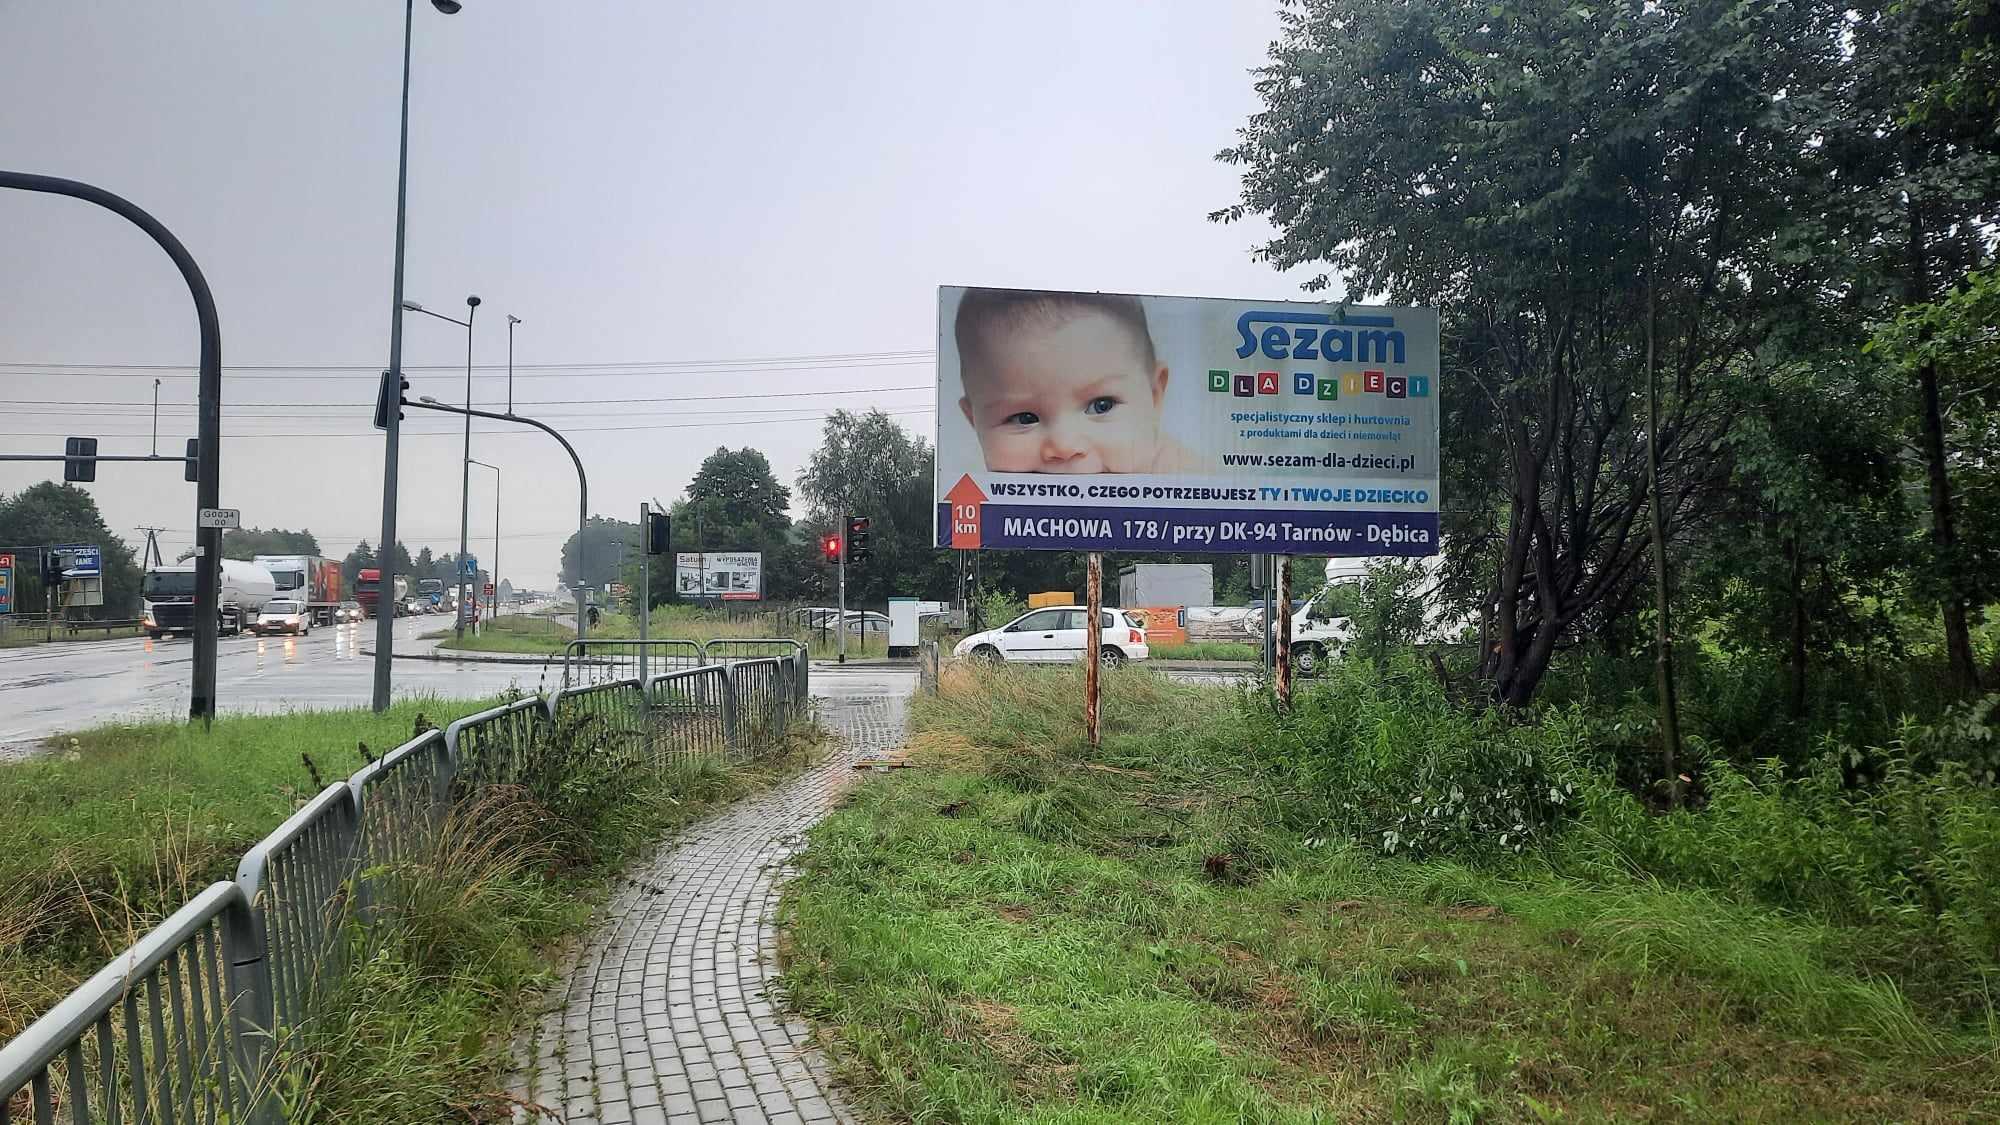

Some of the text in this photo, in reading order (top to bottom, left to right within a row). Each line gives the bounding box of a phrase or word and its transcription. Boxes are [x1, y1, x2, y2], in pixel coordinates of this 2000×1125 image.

[1236, 311, 1405, 363] Sezam
[1212, 374, 1422, 397] DLA DZIECI
[1231, 411, 1314, 426] specjalistyczny
[1316, 412, 1346, 427] sklep
[1354, 413, 1410, 426] hurtownia
[1247, 428, 1302, 439] produktami
[1304, 428, 1318, 439] dla
[1320, 429, 1346, 440] dzieci
[1223, 452, 1415, 472] www.sezam-dla-dzieci.pl
[990, 483, 1084, 499] WSZYSTKO,
[1087, 485, 1140, 499] CZEGO
[1142, 486, 1256, 501] POTRZEBUJESZ
[1259, 487, 1281, 501] TY
[1290, 487, 1351, 502] TWOJE
[1354, 489, 1429, 504] DZIECKO
[955, 504, 976, 520] 10
[954, 519, 977, 534] km
[1003, 517, 1113, 538] MACHOWA
[1123, 520, 1158, 539] 178
[1173, 524, 1216, 544] przy
[1220, 521, 1277, 541] DK-94
[1281, 523, 1352, 542] Tarnów
[1367, 524, 1429, 547] Dębica
